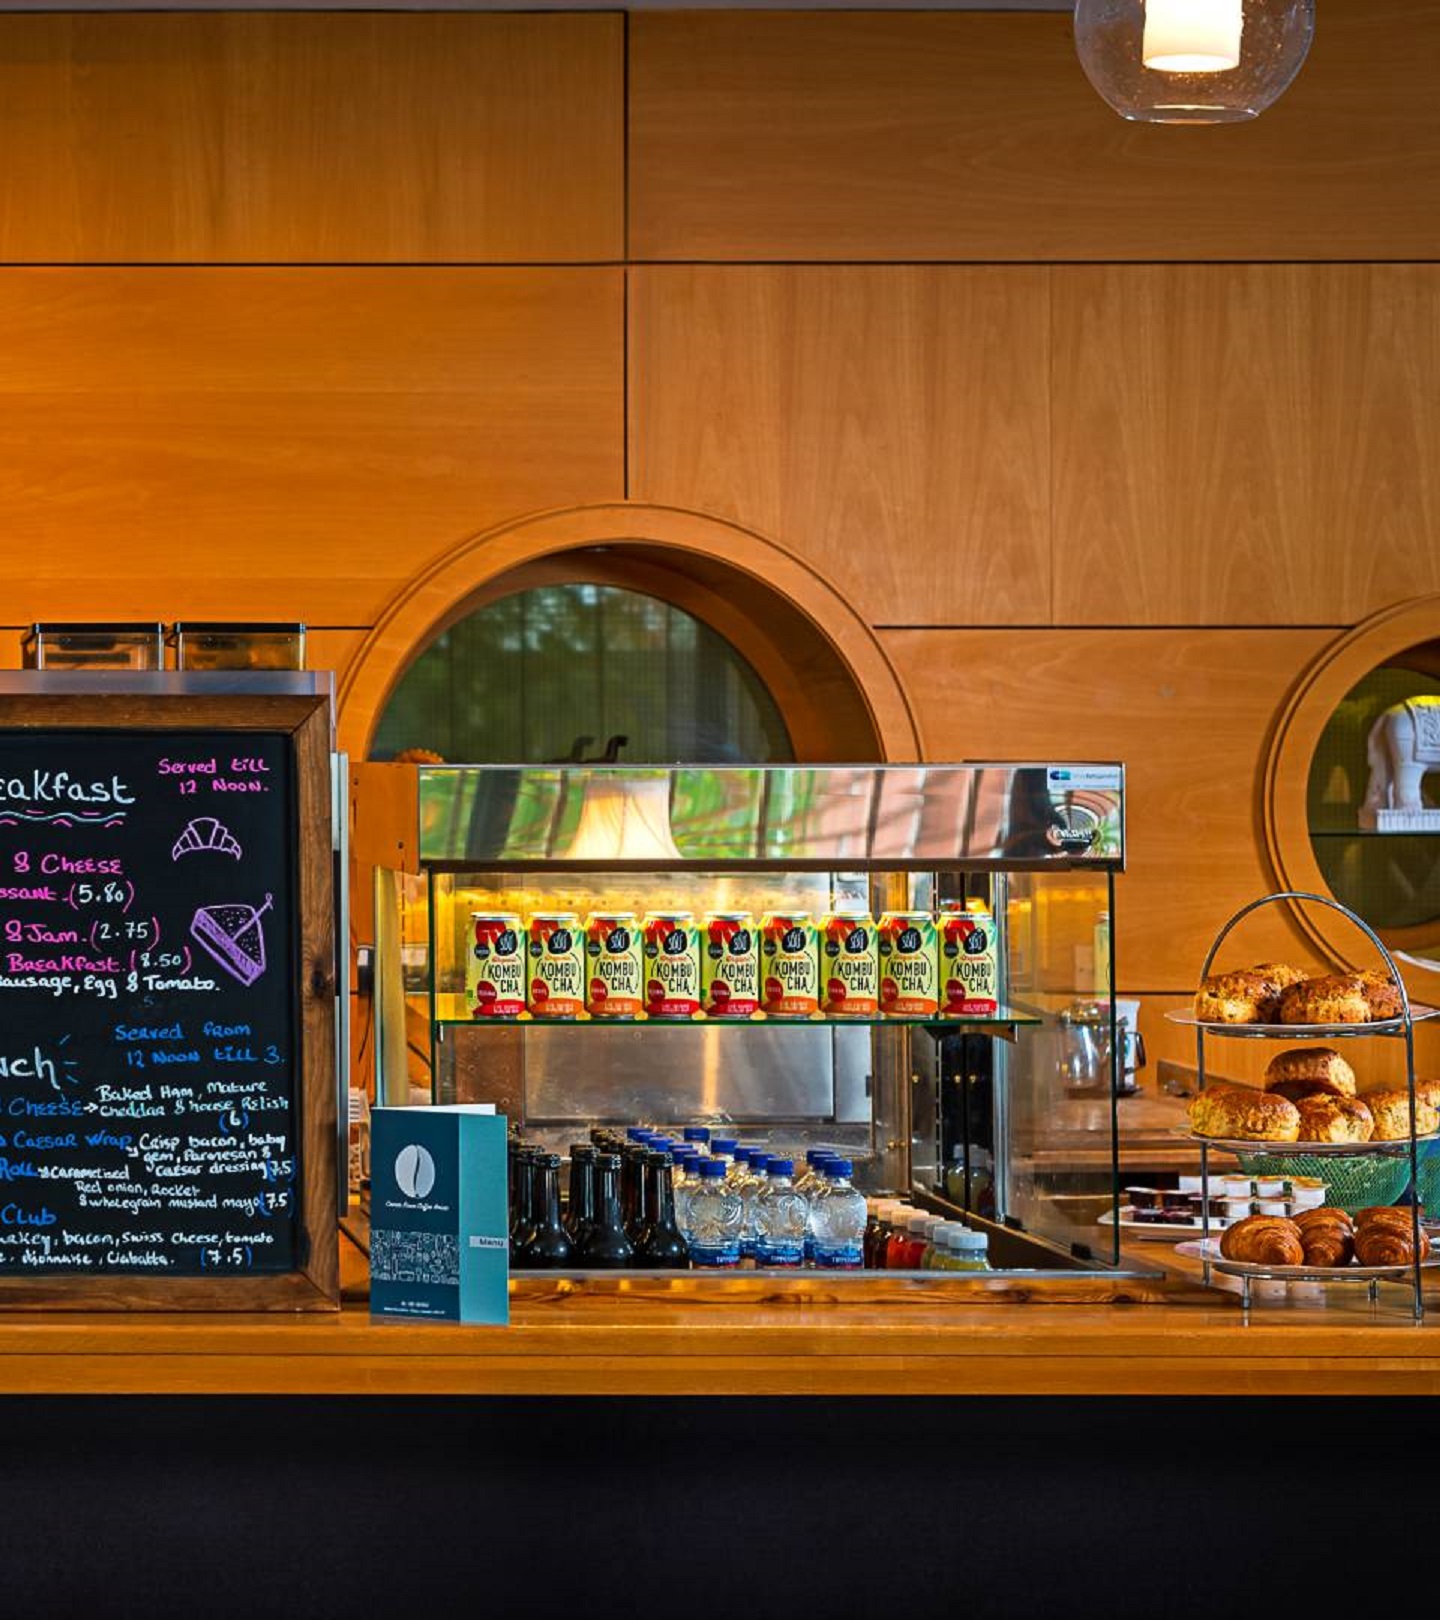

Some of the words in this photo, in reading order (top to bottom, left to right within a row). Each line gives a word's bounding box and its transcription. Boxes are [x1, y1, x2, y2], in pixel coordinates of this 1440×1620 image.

[158, 758, 217, 774] Served
[231, 758, 270, 772] till
[179, 780, 197, 794] 12
[14, 852, 31, 873] &
[70, 880, 135, 914] (5.80)
[5, 919, 23, 942] &
[91, 916, 160, 953] (2.75)
[130, 946, 192, 975] (8.50)
[488, 964, 522, 983] KOMBU
[540, 962, 576, 981] KOMBU
[599, 962, 634, 981] KOMBU
[657, 962, 693, 982] KOMBU
[721, 963, 756, 982] KOMBU
[775, 962, 811, 979] KOMBU
[837, 962, 873, 980] KOMBU
[890, 962, 927, 980] KOMBU
[956, 963, 991, 982] KOMBU
[83, 974, 118, 999] Egg
[125, 971, 139, 992] &
[500, 979, 522, 996] CHA
[553, 977, 576, 995] CHA
[611, 977, 634, 995] CHA
[668, 978, 693, 996] CHA
[733, 978, 756, 995] CHA
[787, 976, 811, 994] CHA
[849, 977, 873, 994] CHA
[902, 977, 927, 994] CHA
[968, 978, 994, 996] CHA
[126, 1050, 145, 1068] 12
[213, 1046, 260, 1061] till
[95, 1083, 153, 1101] Baked
[173, 1099, 186, 1114] &
[218, 1108, 249, 1134] (6)
[248, 1133, 287, 1153] baby
[209, 1160, 268, 1180] dressing
[74, 1180, 103, 1194] Red
[168, 1194, 217, 1209] mustard
[225, 1231, 275, 1244] tomato
